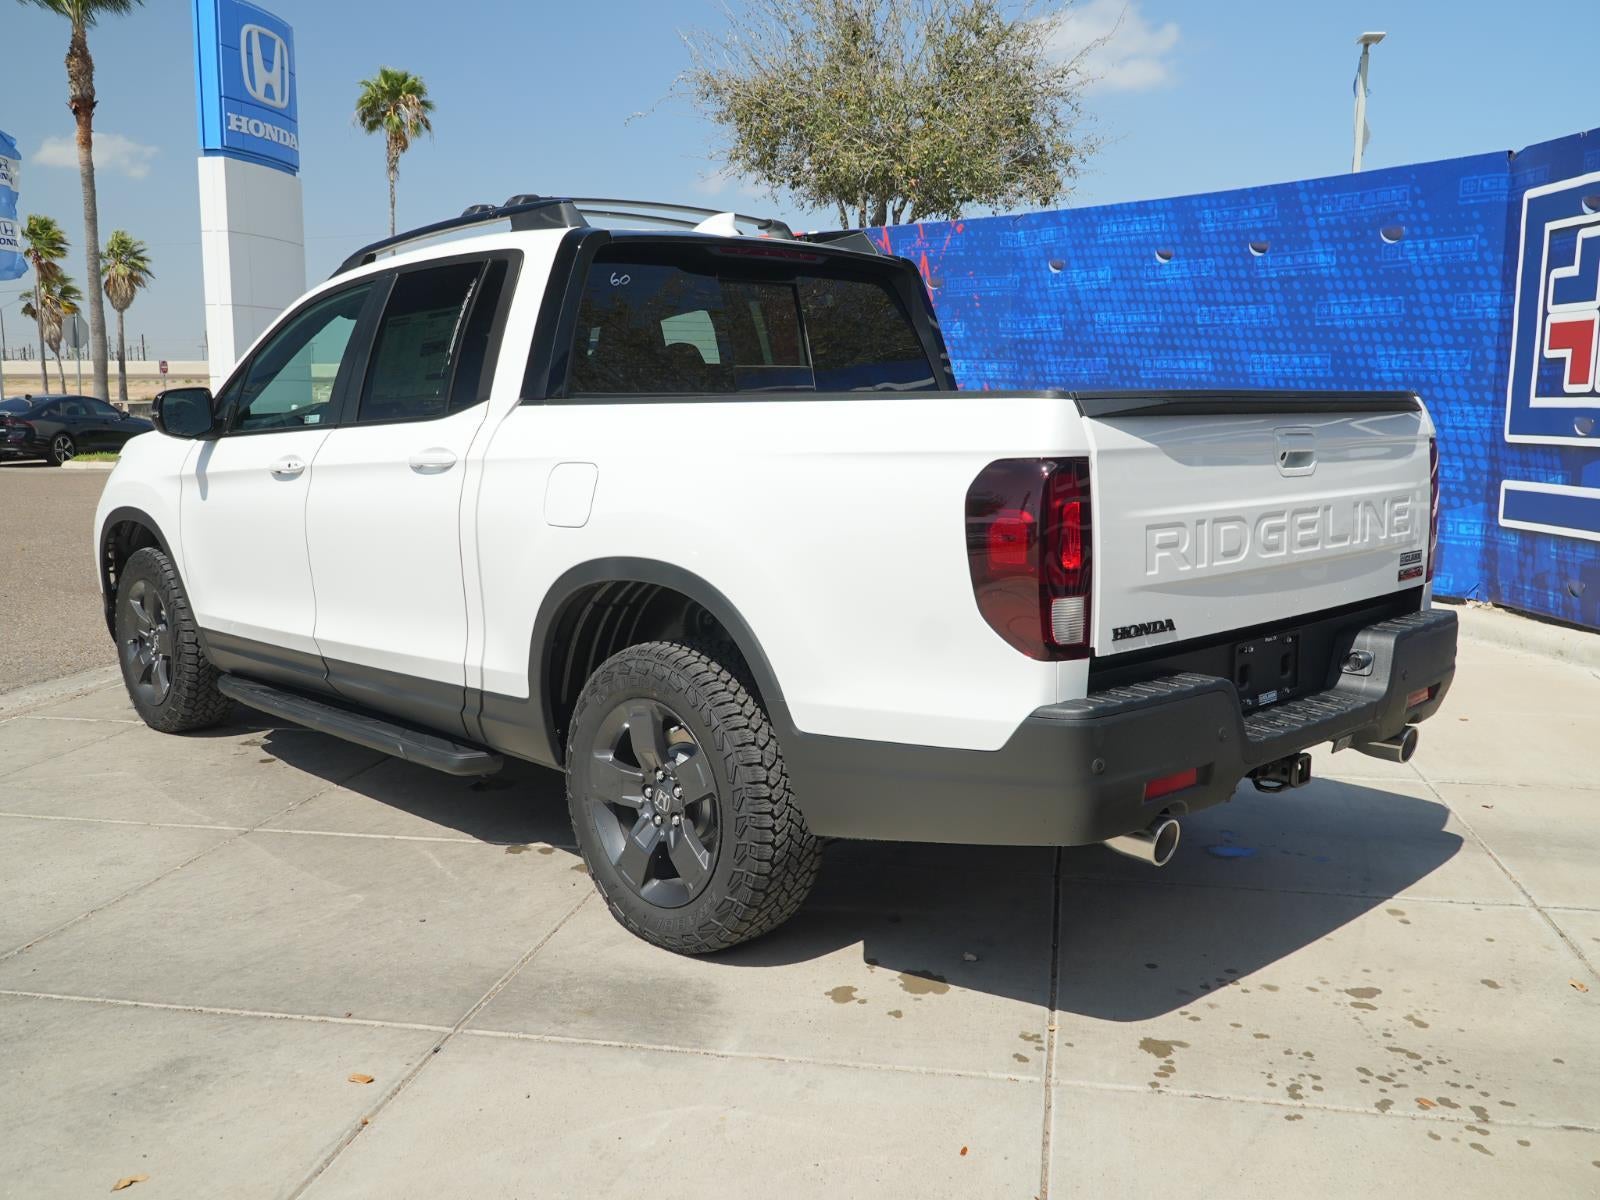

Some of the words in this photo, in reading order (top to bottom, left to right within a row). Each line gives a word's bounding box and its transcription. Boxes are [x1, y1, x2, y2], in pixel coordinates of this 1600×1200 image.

[227, 112, 299, 150] HONDA
[610, 271, 631, 286] 60
[1145, 495, 1412, 576] RIDGELINE
[1111, 618, 1176, 641] HONDA
